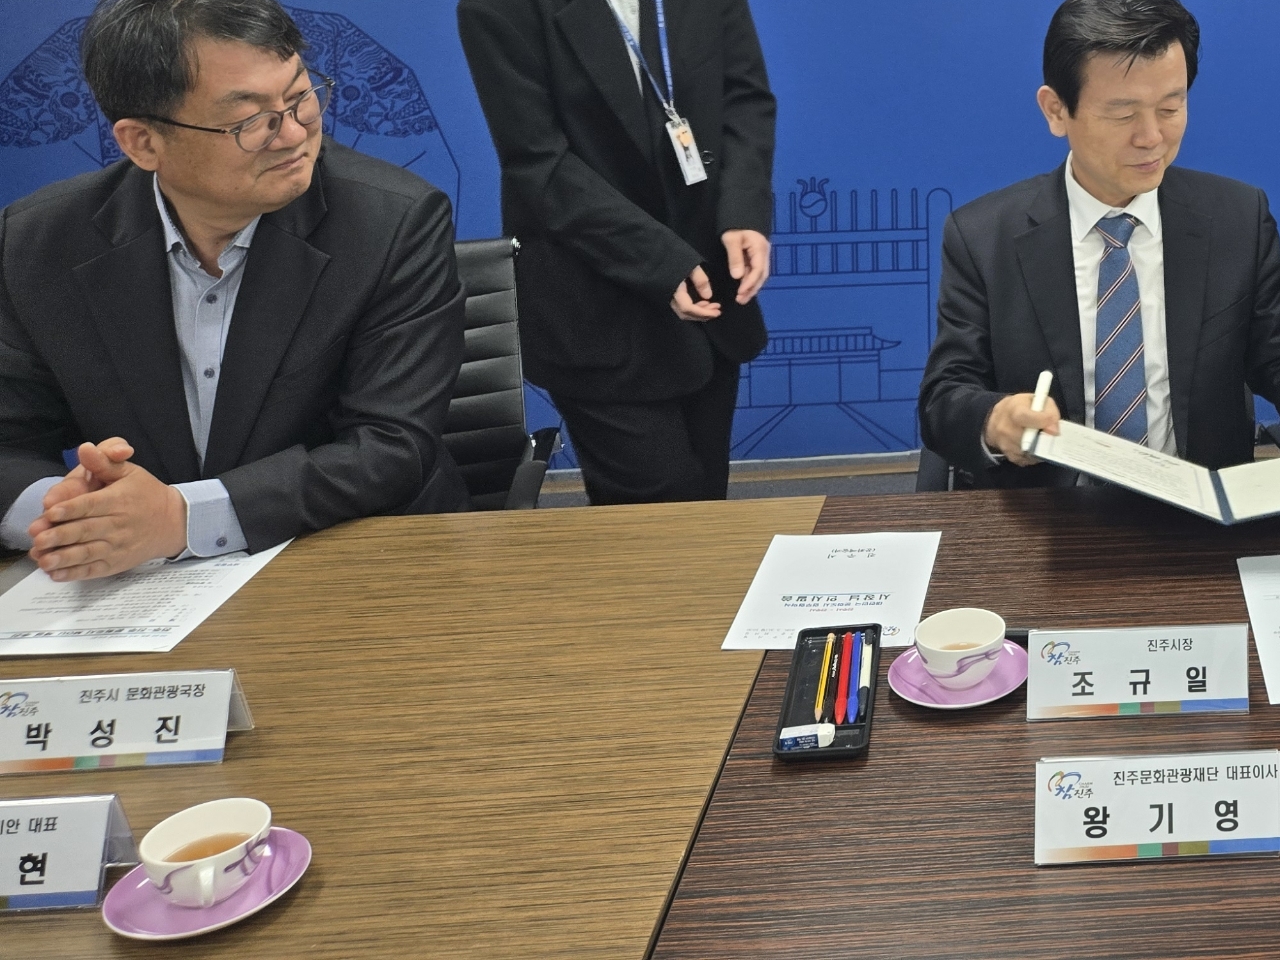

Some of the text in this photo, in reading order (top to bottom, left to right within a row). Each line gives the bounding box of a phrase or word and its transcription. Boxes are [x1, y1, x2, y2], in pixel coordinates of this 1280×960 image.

[1147, 638, 1194, 653] 진주시장
[79, 683, 206, 704] 진주시 문화관광국장
[1113, 763, 1279, 786] 진주문화관광재단 대표이사
[28, 816, 59, 833] 대표
[18, 852, 48, 886] 현
